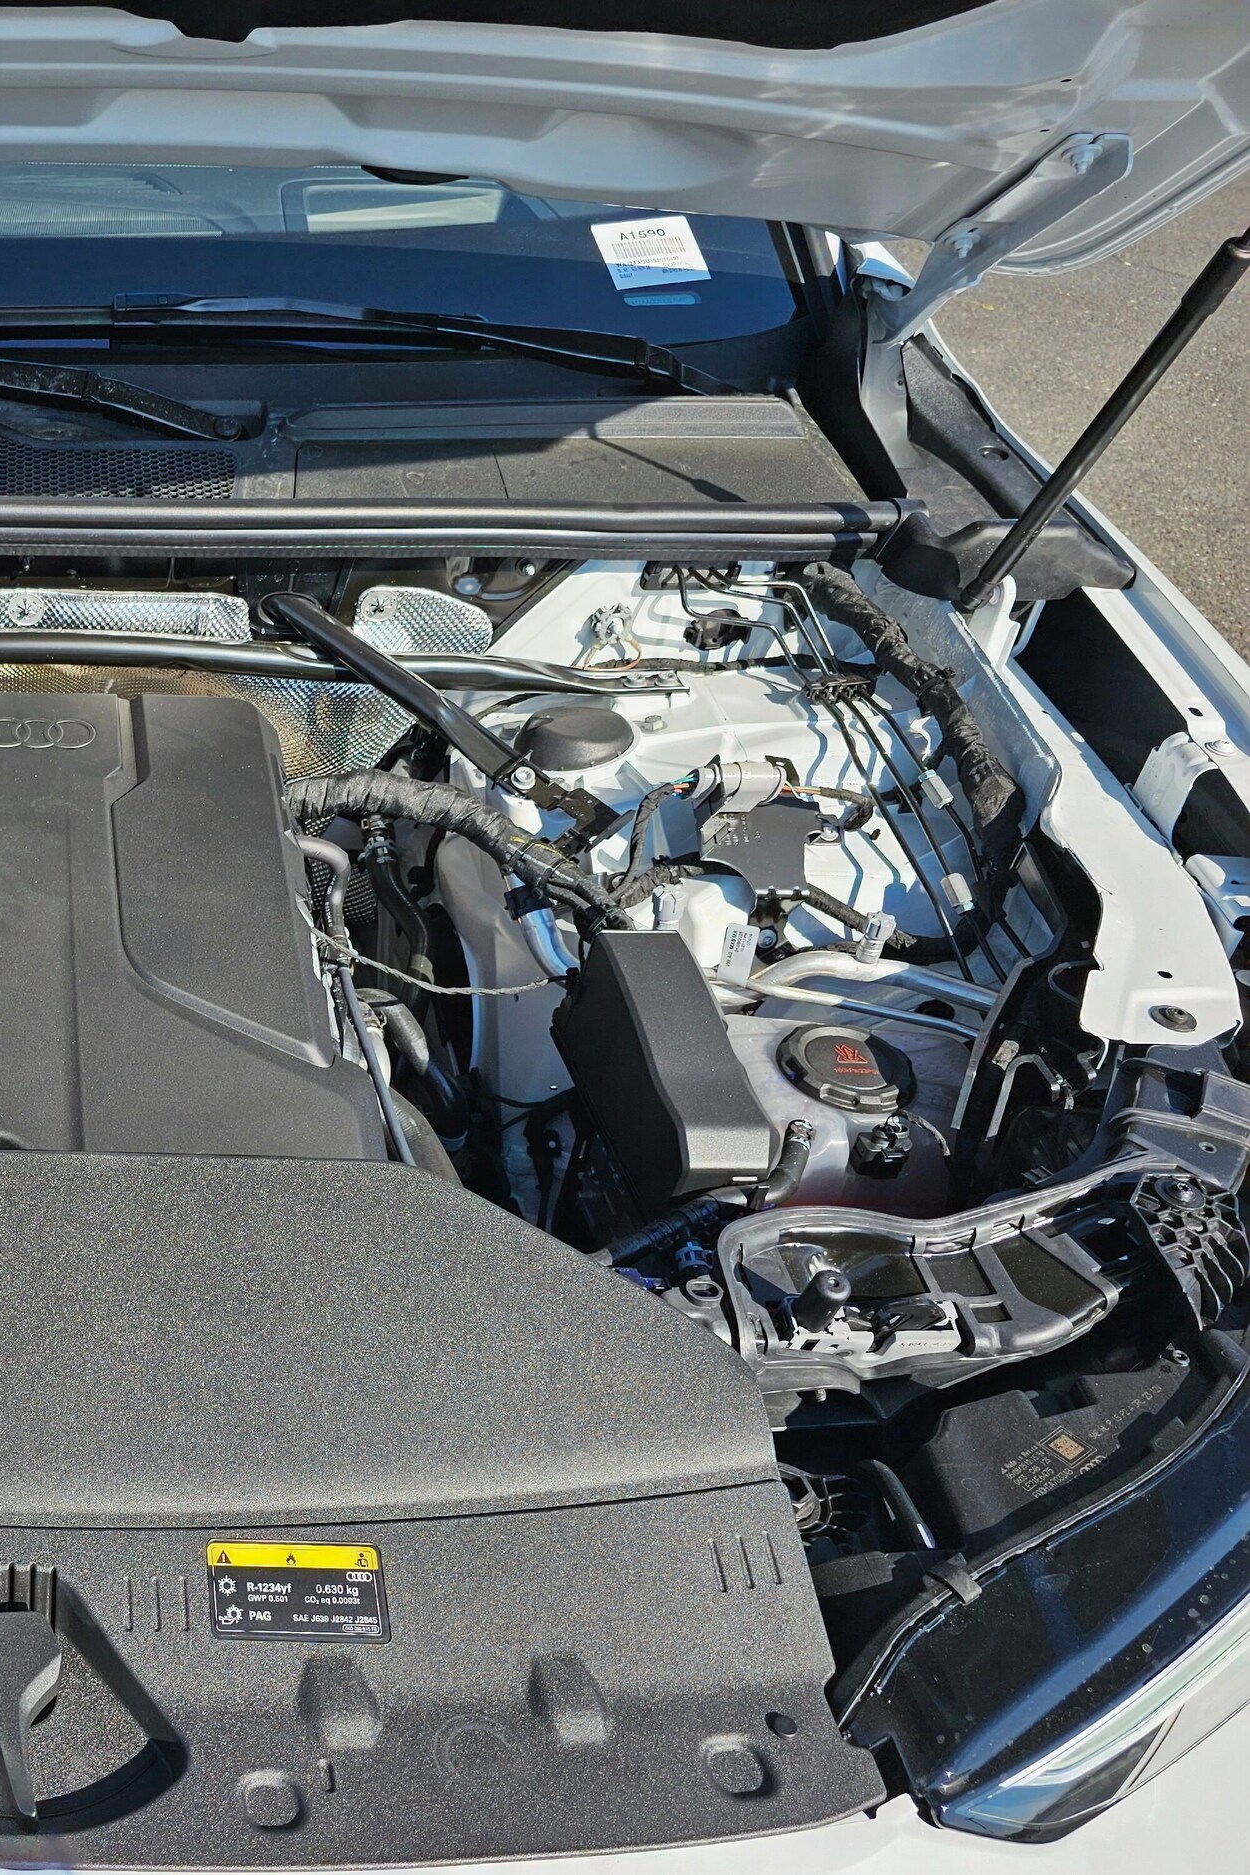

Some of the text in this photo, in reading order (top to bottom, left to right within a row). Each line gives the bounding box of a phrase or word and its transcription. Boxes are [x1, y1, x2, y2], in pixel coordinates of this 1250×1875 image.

[246, 1582, 292, 1595] R-1234yf
[315, 1584, 359, 1597] 0.630 kg
[248, 1594, 288, 1603] GWP 0.501
[321, 1597, 330, 1605] eq
[332, 1597, 361, 1605] 0.0003t
[249, 1610, 272, 1621] PAG
[293, 1614, 309, 1622] SAE
[331, 1615, 353, 1623] J2842
[355, 1616, 378, 1624] J2845
